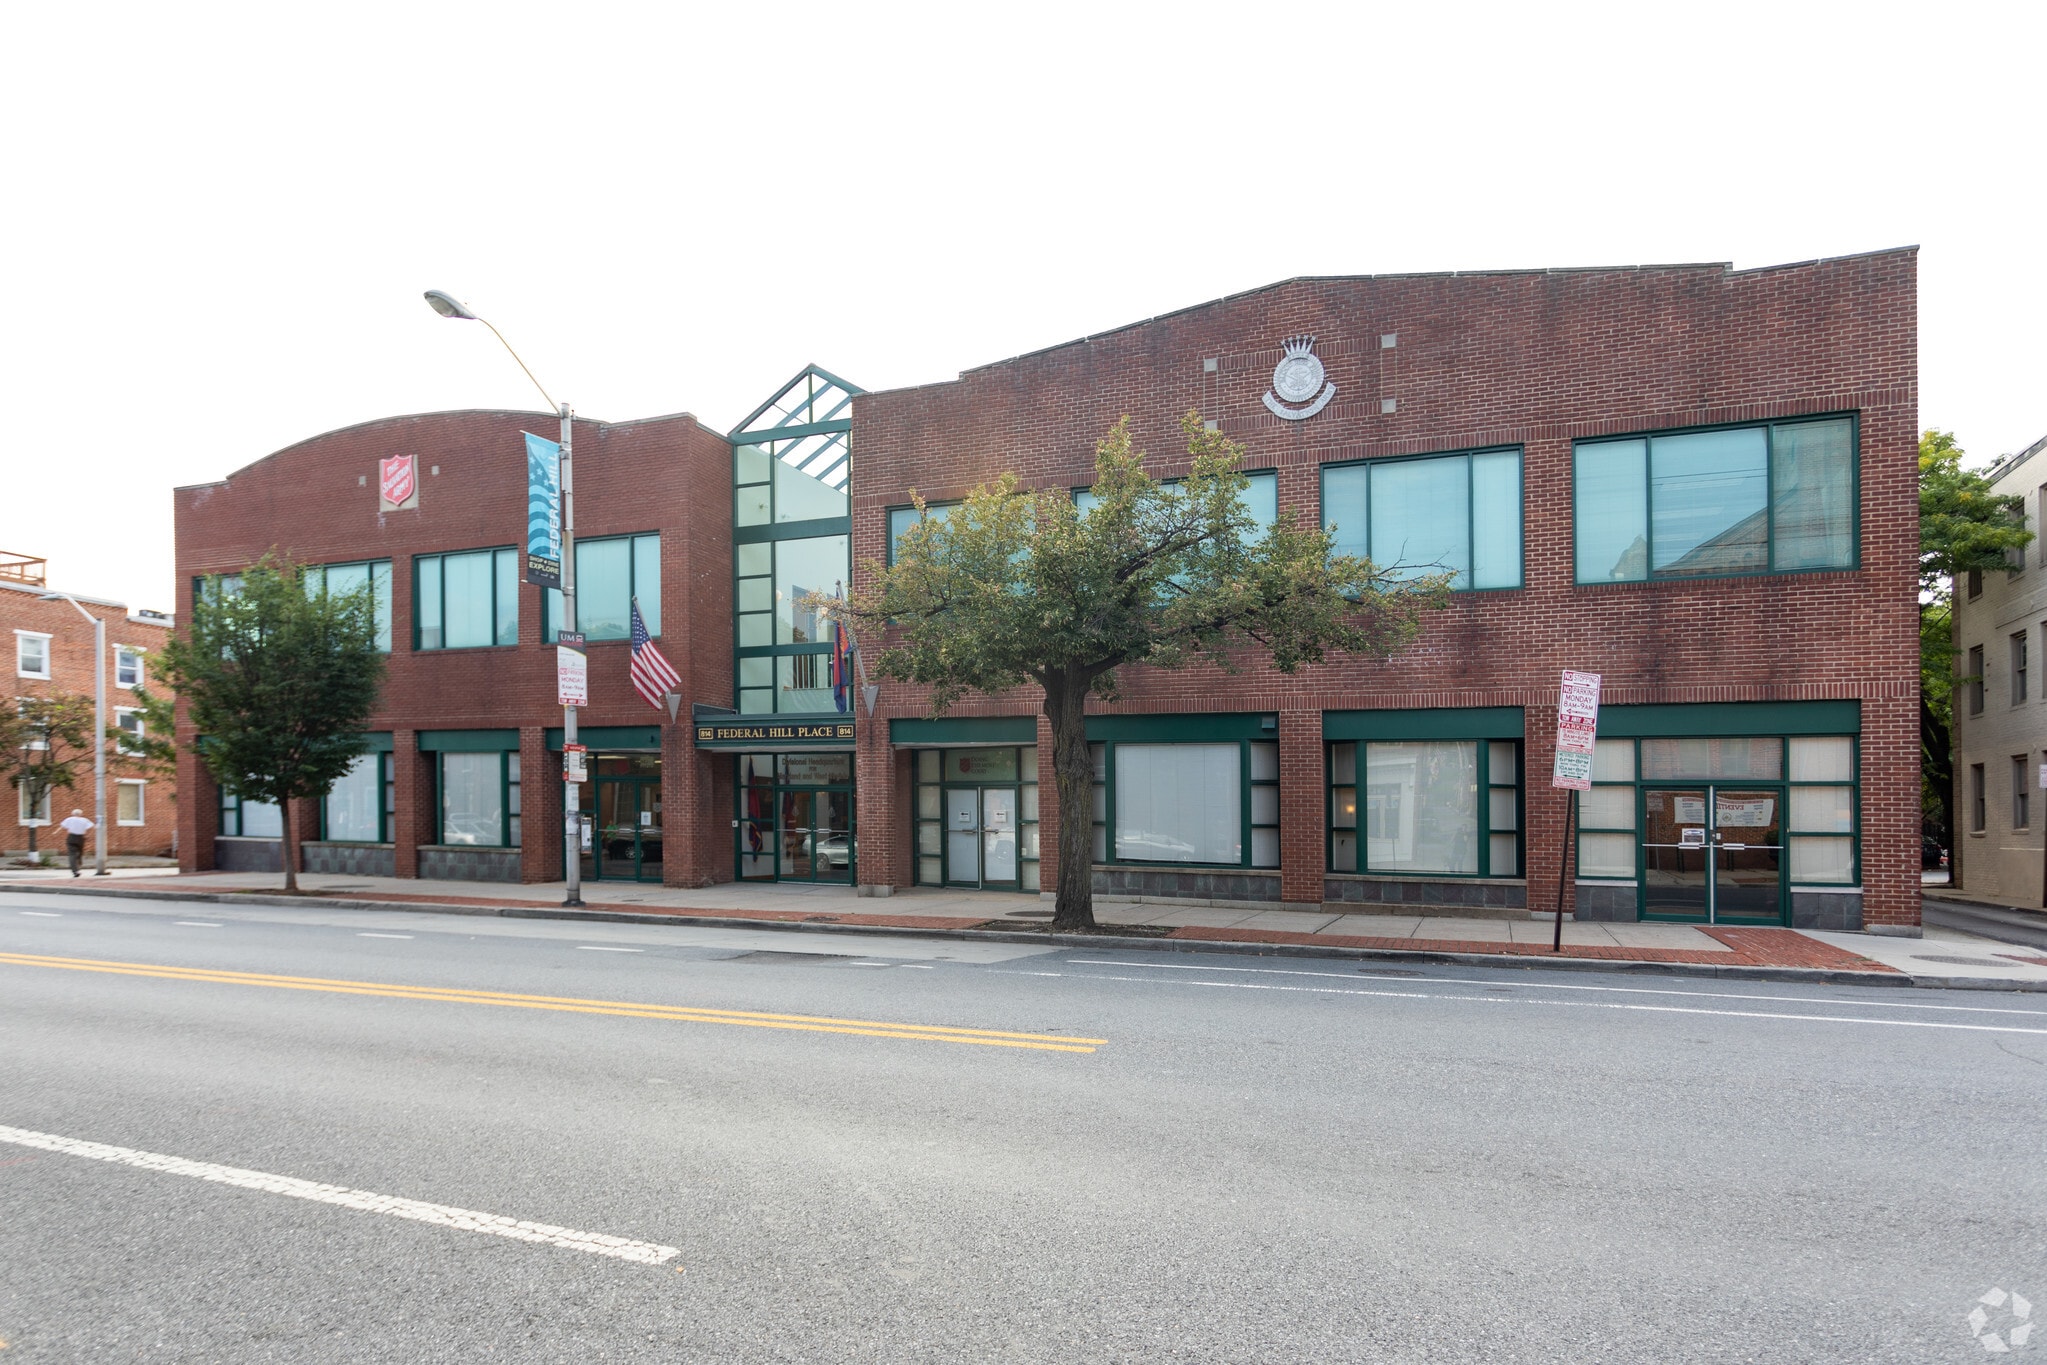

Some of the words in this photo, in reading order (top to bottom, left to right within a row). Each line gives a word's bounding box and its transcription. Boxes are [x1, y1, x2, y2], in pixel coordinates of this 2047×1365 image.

[387, 460, 400, 477] THE
[548, 453, 560, 489] HILL
[549, 490, 560, 559] FEDERAL
[528, 561, 560, 575] EXPLORE
[1564, 672, 1573, 681] NO
[1574, 674, 1598, 683] STOPPING
[1563, 686, 1572, 694] NO
[1573, 687, 1596, 696] PARKING
[1566, 695, 1593, 703] MONDAY
[1564, 700, 1594, 710] 8AM-9AM
[717, 728, 766, 739] FEDERAL
[769, 727, 795, 738] HILL
[798, 726, 834, 737] PLACE
[839, 727, 851, 735] 814
[1561, 723, 1594, 731] PARKING
[781, 757, 807, 765] Divisional
